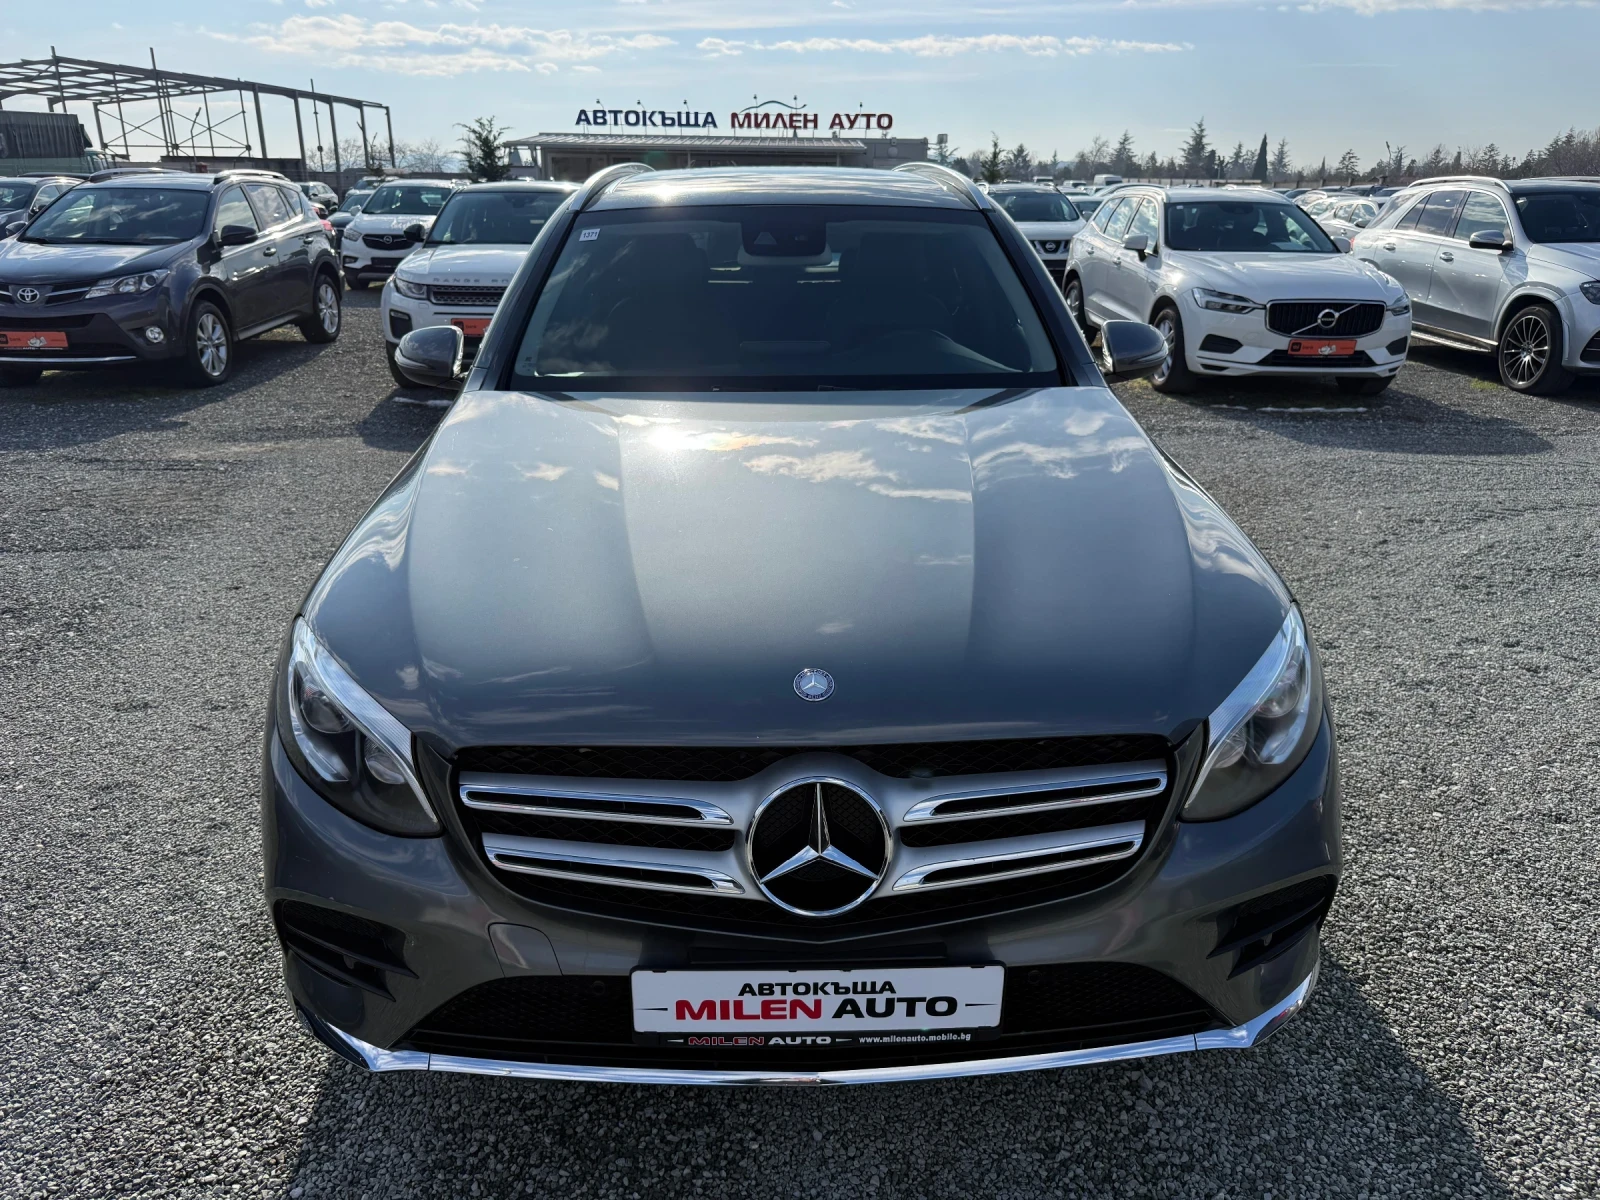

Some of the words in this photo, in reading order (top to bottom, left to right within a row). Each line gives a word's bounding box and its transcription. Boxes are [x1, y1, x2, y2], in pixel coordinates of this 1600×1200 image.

[575, 109, 718, 128] АВТОКЪЩА
[730, 112, 818, 130] МИЛЕН
[829, 113, 893, 130] АУТО
[738, 981, 897, 996] АВТОКЪЩА
[675, 999, 822, 1021] MILEN
[832, 997, 958, 1019] AUTO
[688, 1036, 765, 1046] MILEN
[768, 1036, 832, 1045] AUTO
[859, 1032, 971, 1043] www.milenauto.mobile.bg
